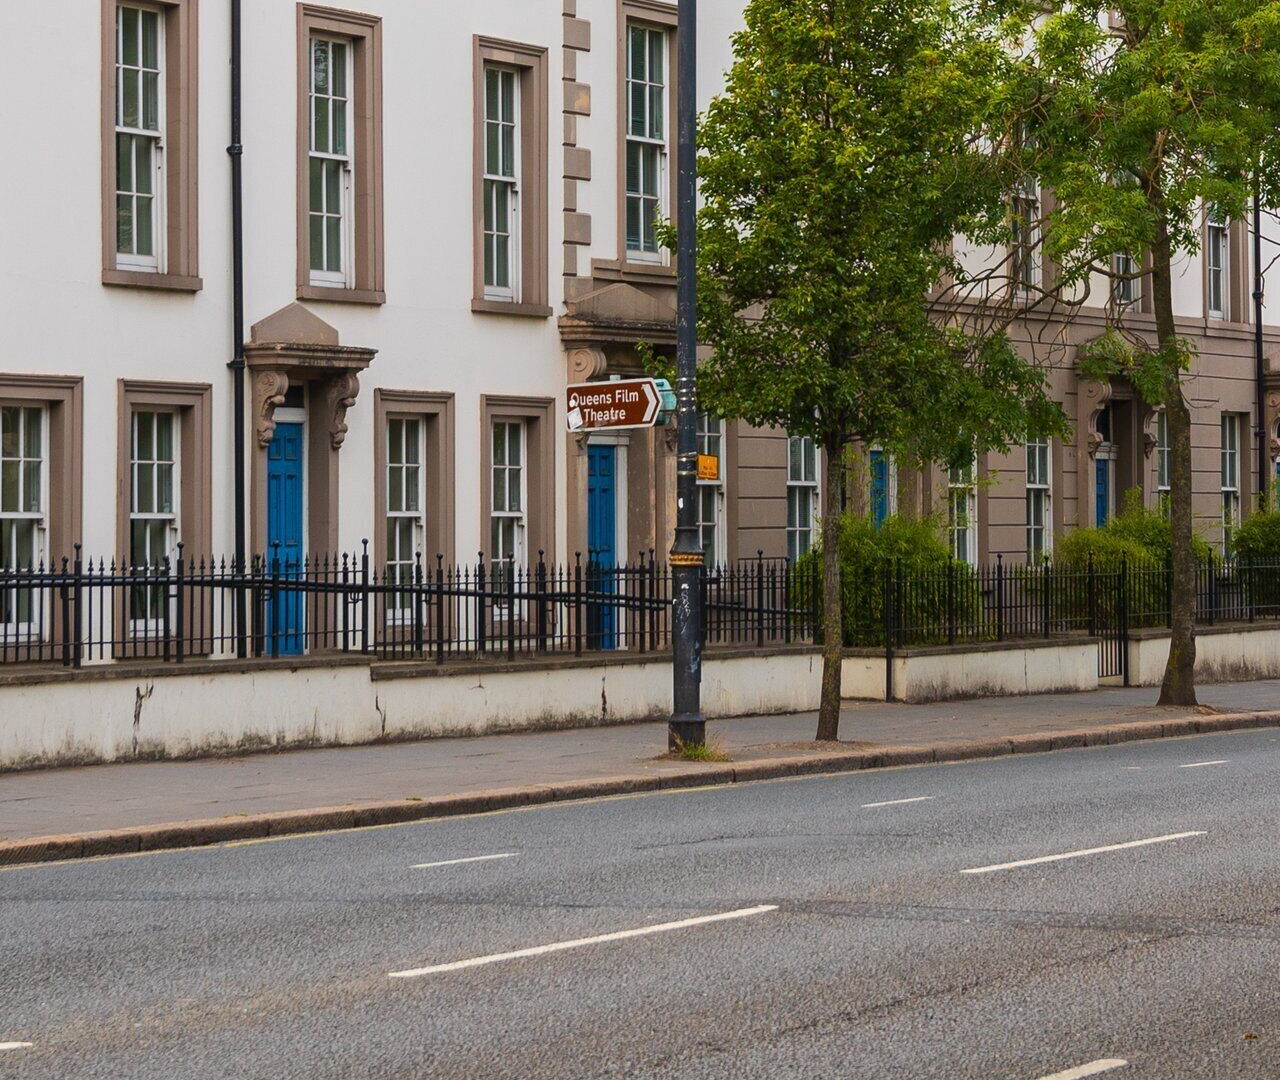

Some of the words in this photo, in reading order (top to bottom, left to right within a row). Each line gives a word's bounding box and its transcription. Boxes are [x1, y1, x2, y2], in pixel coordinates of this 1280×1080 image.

[569, 392, 612, 407] Queens
[615, 390, 639, 403] Film
[583, 407, 626, 422] Theatre
